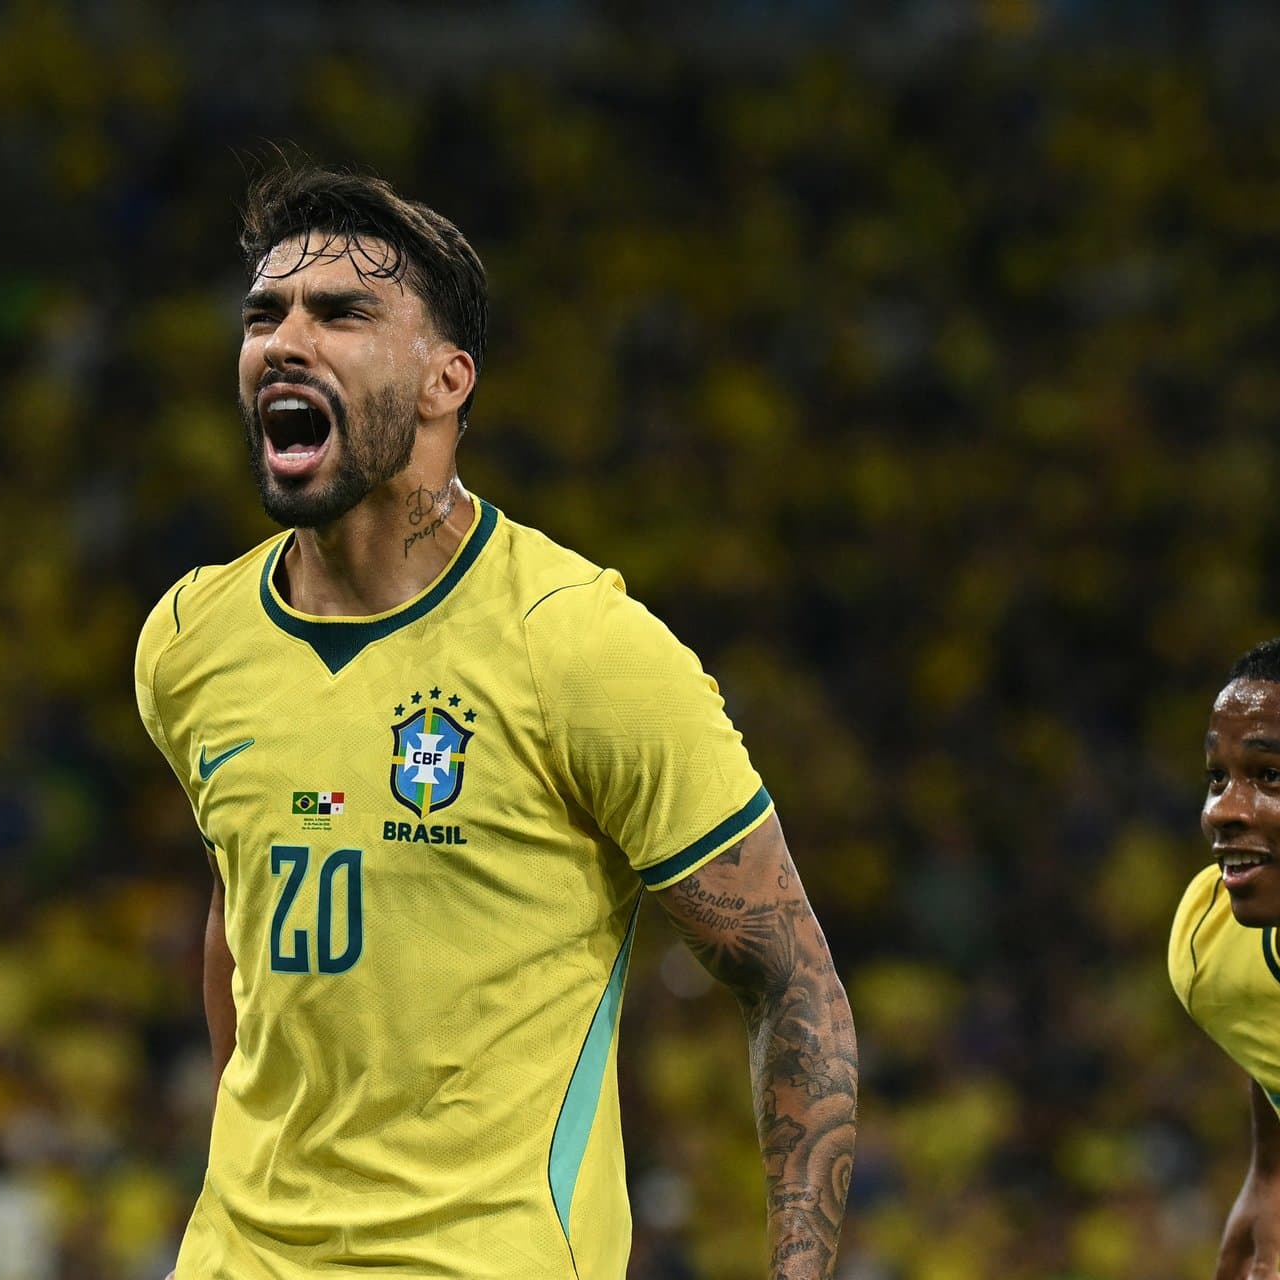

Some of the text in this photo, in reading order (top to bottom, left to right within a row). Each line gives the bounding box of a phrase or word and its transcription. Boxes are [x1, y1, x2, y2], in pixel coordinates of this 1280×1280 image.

[411, 750, 443, 766] CBF
[382, 820, 468, 845] BRASIL
[270, 845, 363, 976] 20
